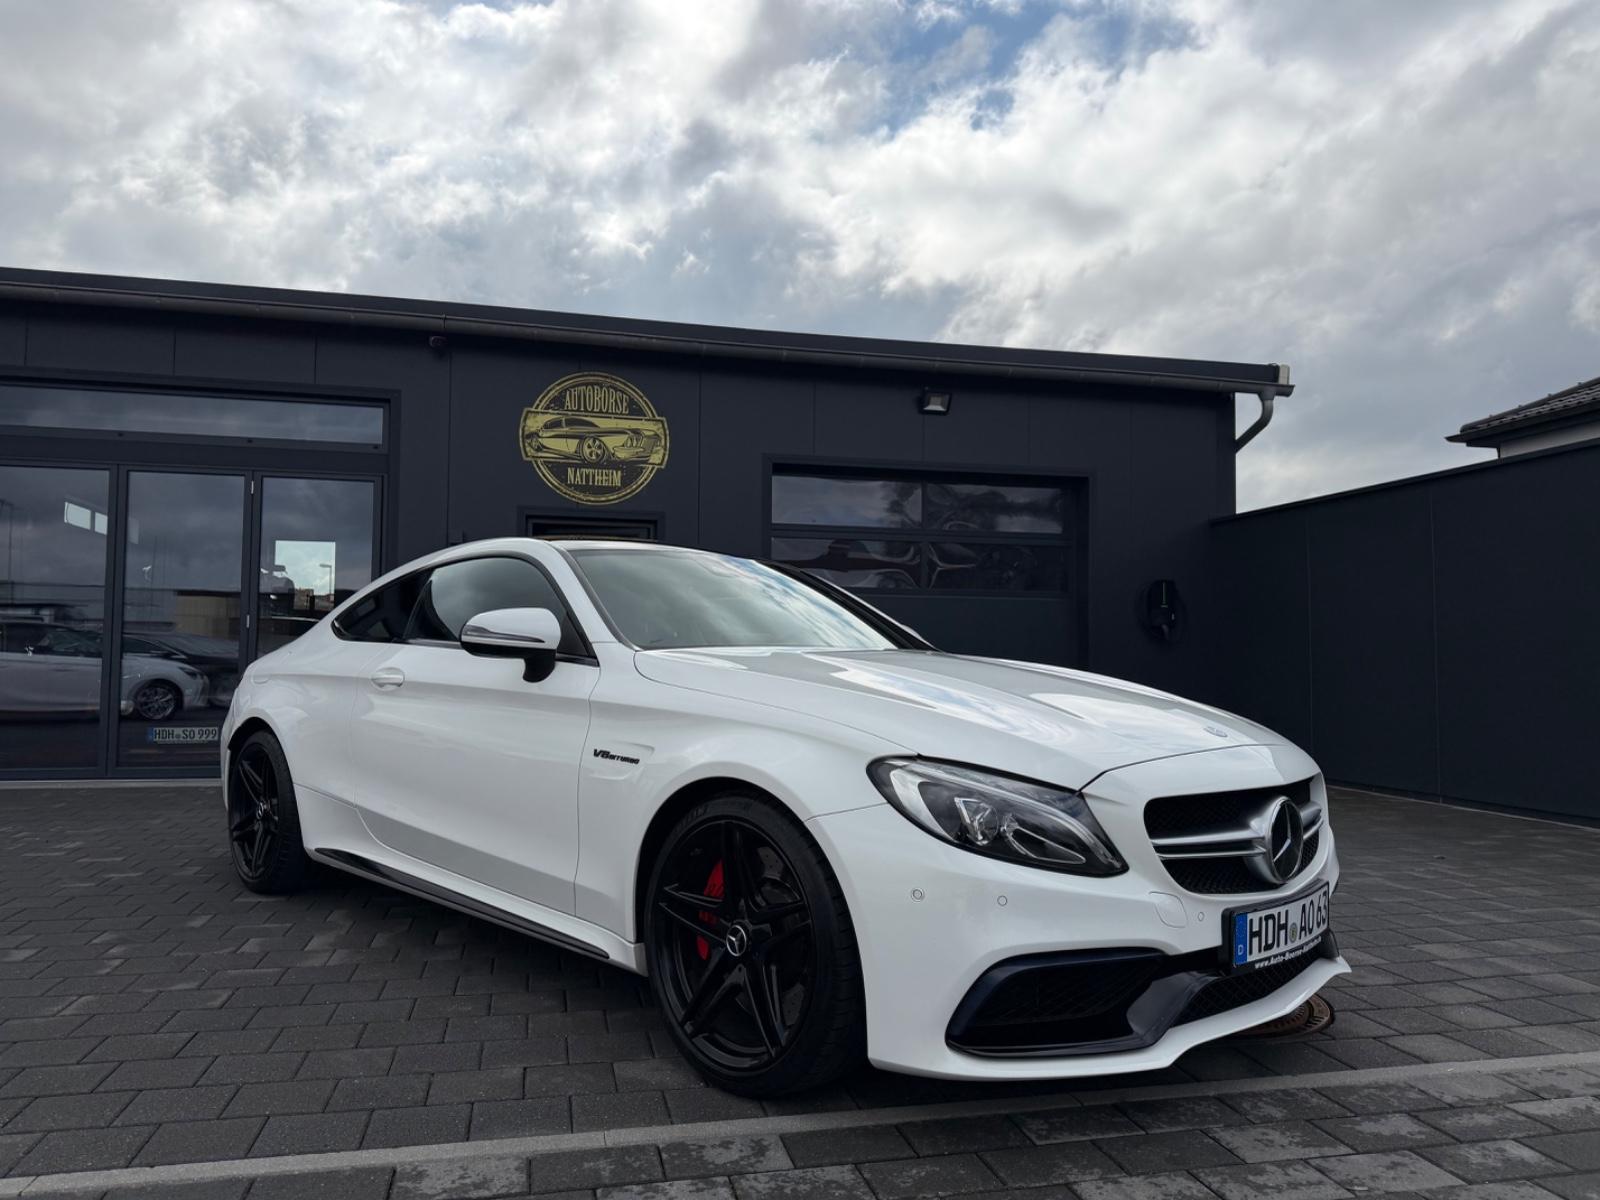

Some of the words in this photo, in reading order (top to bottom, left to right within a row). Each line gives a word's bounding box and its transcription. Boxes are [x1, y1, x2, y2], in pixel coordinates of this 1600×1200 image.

[567, 467, 622, 487] NATTHEIM
[154, 728, 175, 740] HDH
[182, 728, 196, 740] SO
[197, 728, 218, 740] 999
[1237, 944, 1244, 956] D
[1248, 909, 1289, 956] HDH
